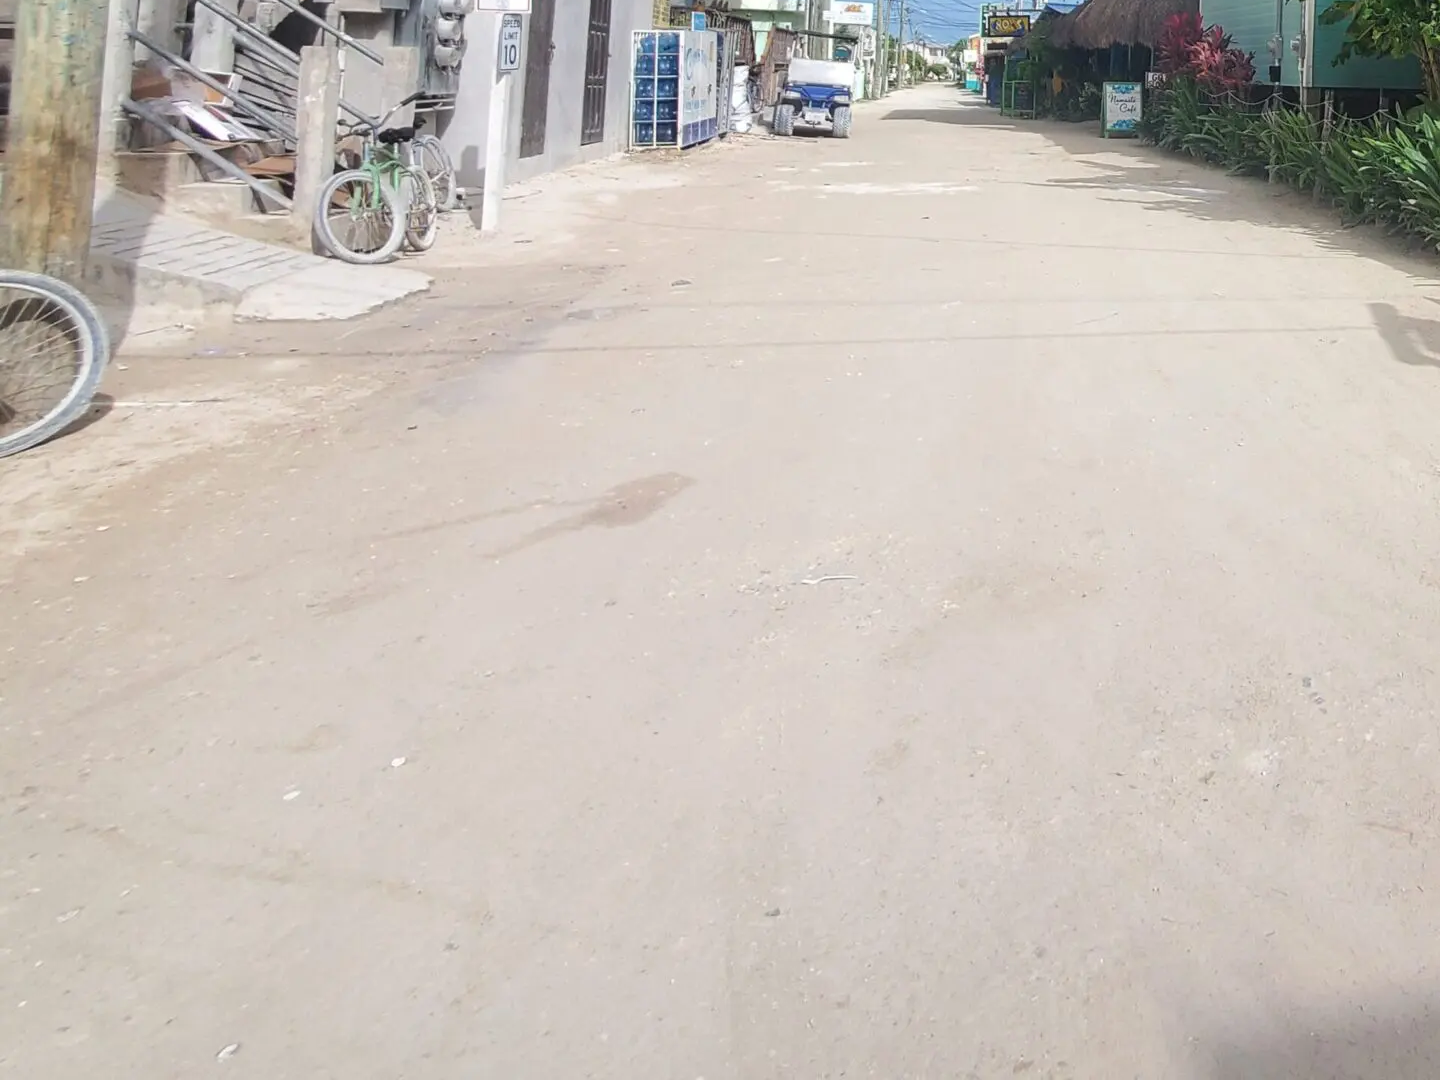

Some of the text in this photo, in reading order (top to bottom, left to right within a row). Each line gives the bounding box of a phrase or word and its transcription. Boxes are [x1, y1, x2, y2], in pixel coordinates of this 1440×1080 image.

[503, 19, 520, 28] SPEED
[504, 32, 518, 41] LIMIT
[504, 44, 517, 65] 10
